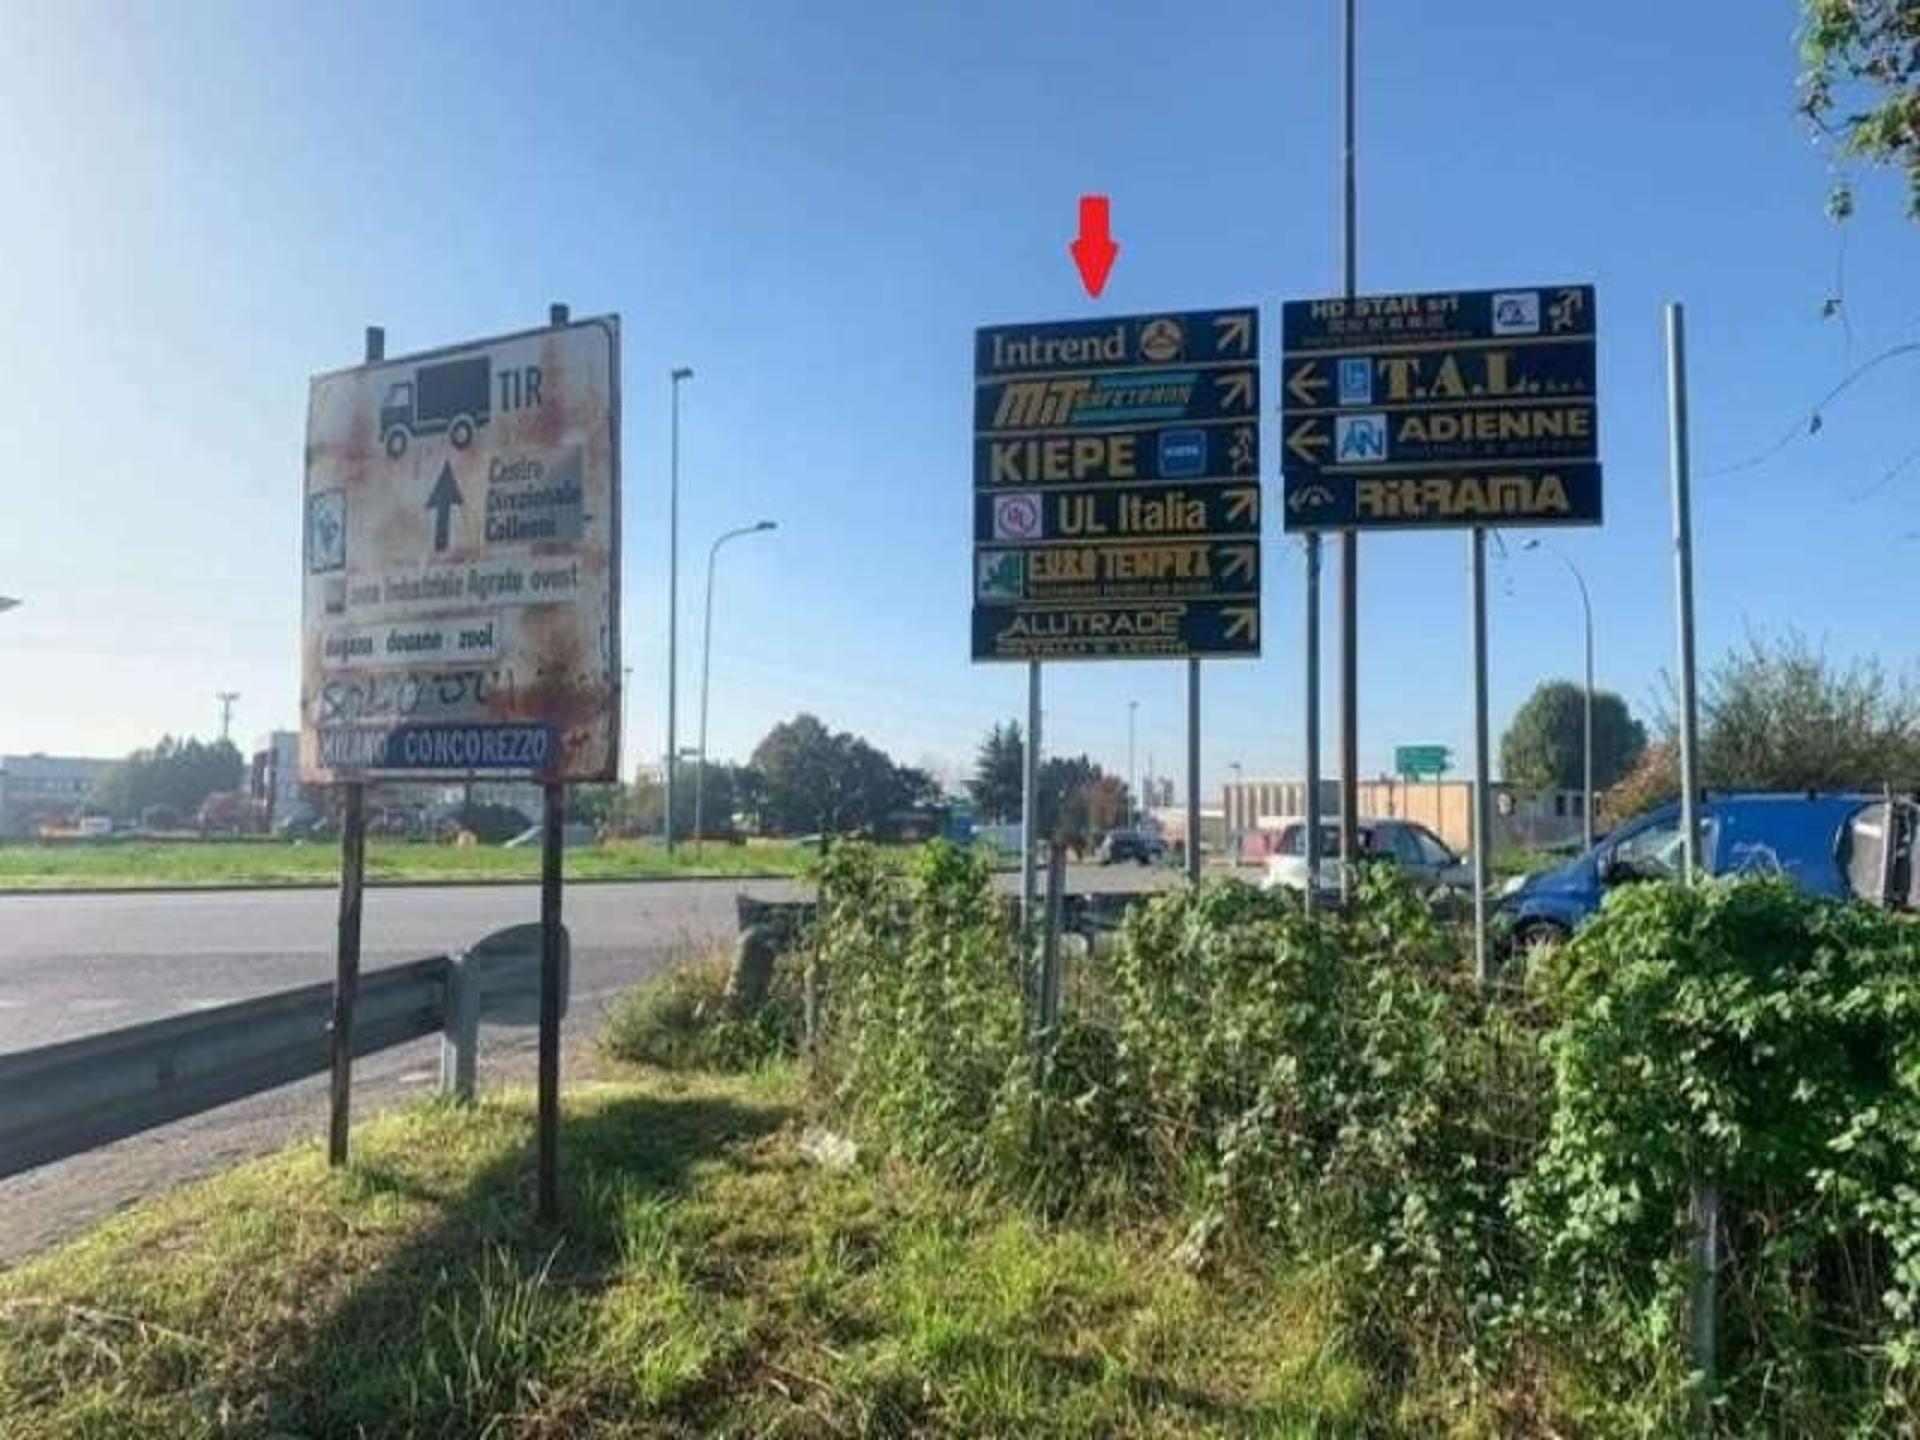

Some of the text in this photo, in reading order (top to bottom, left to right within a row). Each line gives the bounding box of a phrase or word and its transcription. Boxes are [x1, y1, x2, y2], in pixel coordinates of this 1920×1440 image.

[993, 326, 1125, 367] Intrend
[497, 366, 543, 412] TIR
[1397, 409, 1589, 444] ADIENNE
[989, 434, 1136, 482] KIEPE
[1059, 492, 1208, 533] UL Italia
[403, 728, 547, 763] CONCOREZZO
